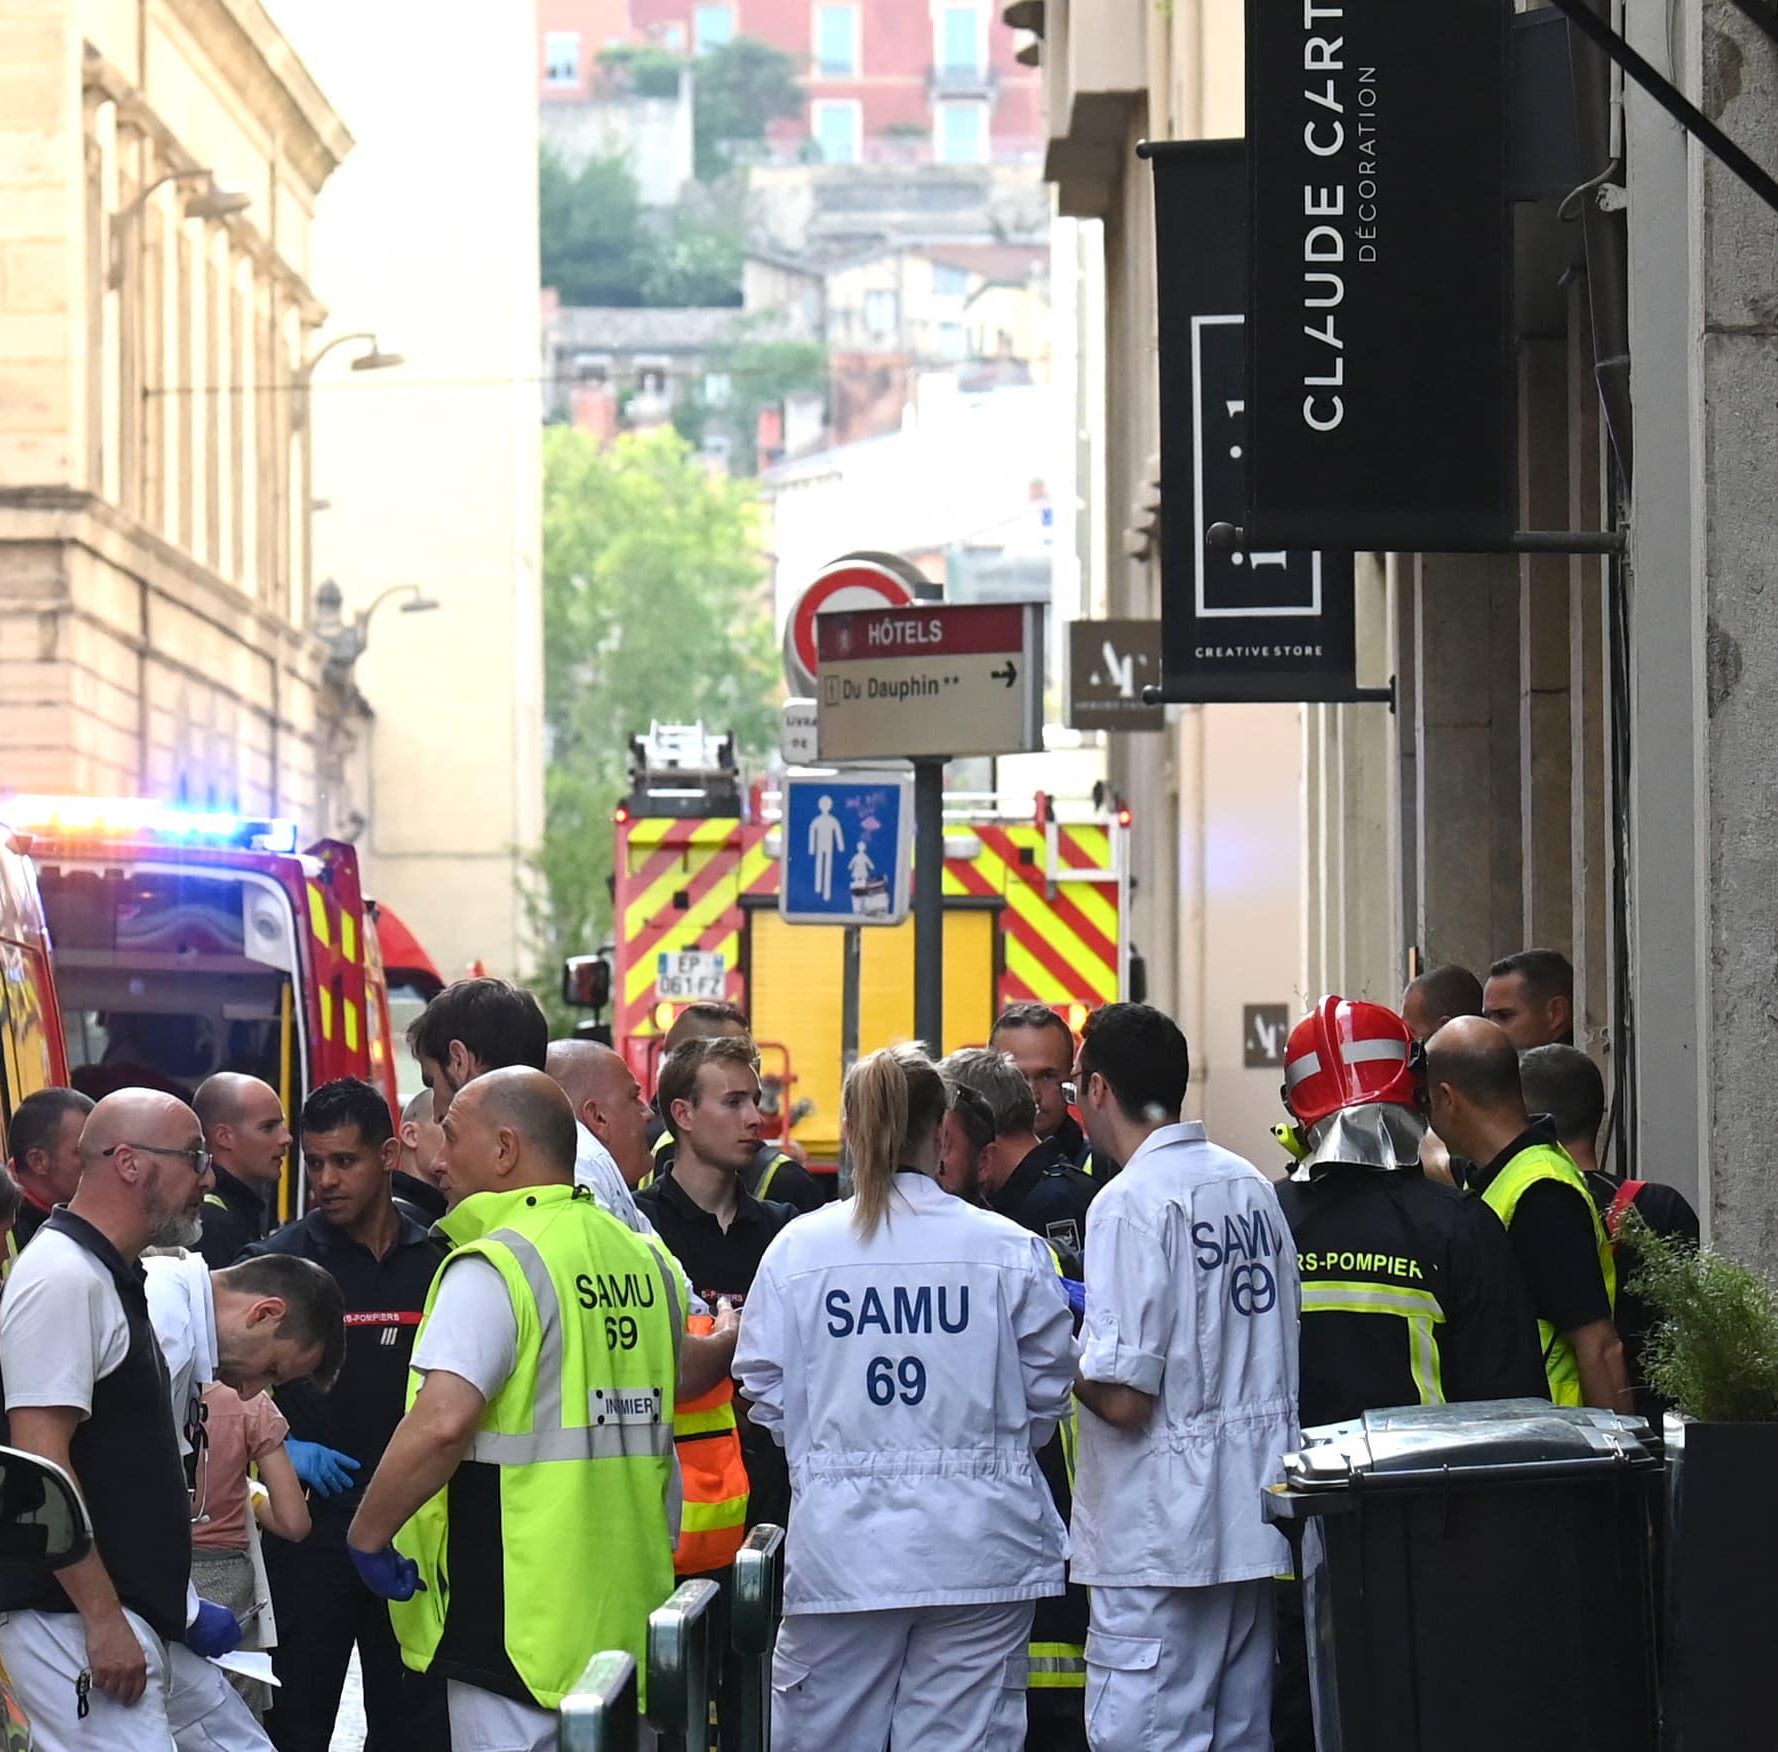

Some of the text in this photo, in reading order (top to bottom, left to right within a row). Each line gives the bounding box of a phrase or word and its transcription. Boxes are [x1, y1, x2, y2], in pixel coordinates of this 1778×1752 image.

[1355, 66, 1377, 262] DÉCORATION
[1303, 185, 1344, 431] CLAUDE
[868, 618, 943, 646] HÔTELS
[1194, 645, 1323, 659] CREATIVE STORE
[842, 678, 862, 700] Du
[575, 1273, 655, 1310] SAMU
[825, 1285, 970, 1338] SAMU
[1230, 1262, 1277, 1317] 69
[604, 1316, 638, 1351] 69
[866, 1355, 927, 1406] 69
